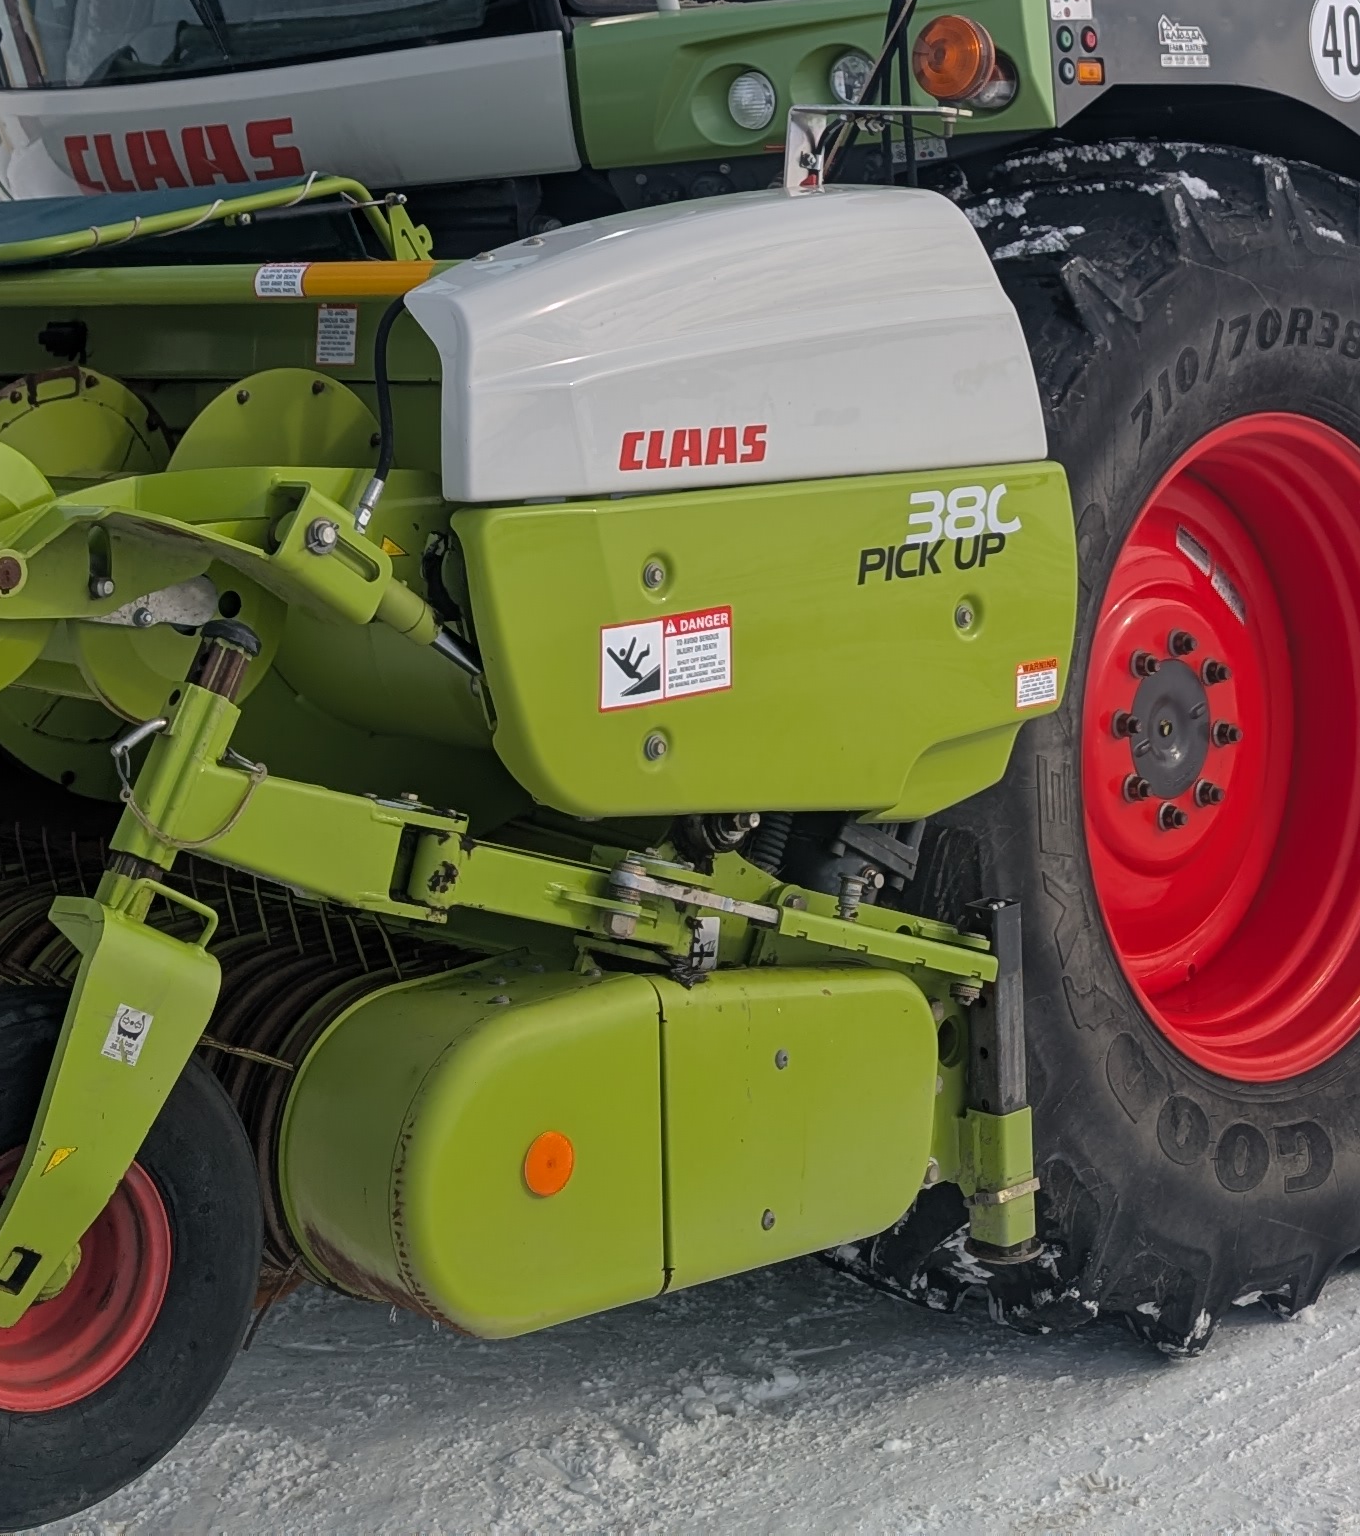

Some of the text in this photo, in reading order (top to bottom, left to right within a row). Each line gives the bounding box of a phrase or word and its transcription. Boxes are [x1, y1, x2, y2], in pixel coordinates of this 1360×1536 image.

[63, 116, 306, 195] CLAAS
[618, 424, 768, 471] CLAAS
[857, 532, 1006, 585] PICK UP
[680, 613, 729, 632] DANGER
[1023, 659, 1056, 672] WARNING
